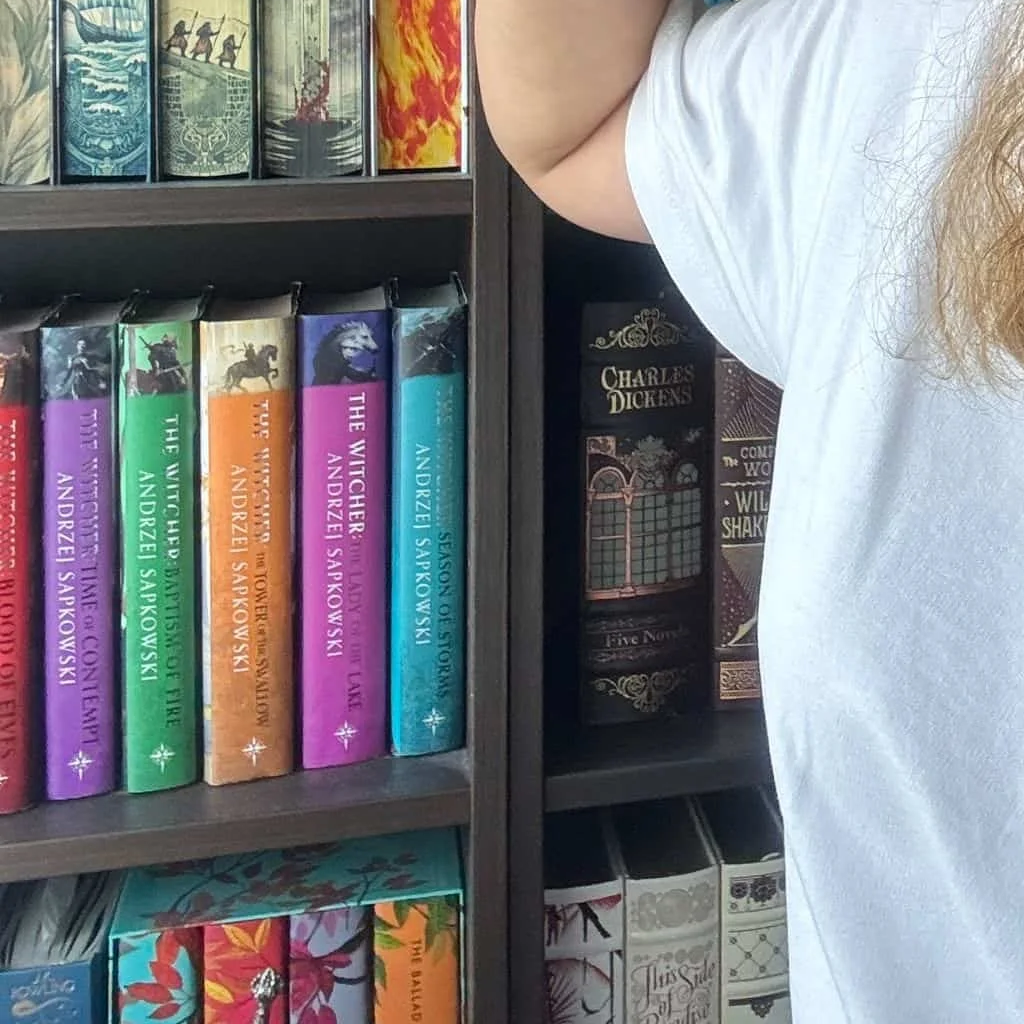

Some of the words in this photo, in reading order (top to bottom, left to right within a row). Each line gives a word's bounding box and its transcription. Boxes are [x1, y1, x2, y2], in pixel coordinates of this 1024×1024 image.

[601, 363, 695, 391] CHARLES
[607, 385, 693, 414] DICKENS
[80, 408, 98, 450] THE
[163, 414, 180, 455] THE
[252, 400, 269, 439] THE
[348, 392, 366, 433] THE
[413, 443, 432, 529] ANDRZEJ
[721, 456, 739, 468] The
[56, 472, 75, 563] ANDRZEJ
[137, 470, 157, 560] ANDRZEJ
[229, 465, 249, 553] ANDRZEJ
[324, 452, 343, 540] ANDRZEJ
[81, 564, 98, 612] TIME
[437, 532, 452, 597] SEASON
[164, 567, 180, 649] BAPTISM
[231, 561, 249, 673] SAPKOWSKI
[255, 571, 268, 624] TOWER
[326, 548, 344, 657] SAPKOWSKI
[348, 570, 363, 615] LADY
[415, 538, 432, 645] SAPKOWSKI
[438, 603, 452, 626] OF
[57, 571, 77, 685] SAPKOWSKI
[83, 615, 94, 630] OF
[139, 568, 158, 681] SAPKOWSKI
[605, 632, 639, 647] Five
[81, 635, 99, 745] CONTEMPT
[165, 655, 180, 679] OF
[437, 632, 452, 699] STORMS
[165, 687, 182, 728] FIRE
[255, 657, 270, 727] SWALLOW
[347, 672, 362, 712] LAKE
[409, 939, 422, 962] THE
[410, 970, 422, 1022] BALLAD
[631, 959, 677, 1016] This
[678, 956, 717, 994] Side
